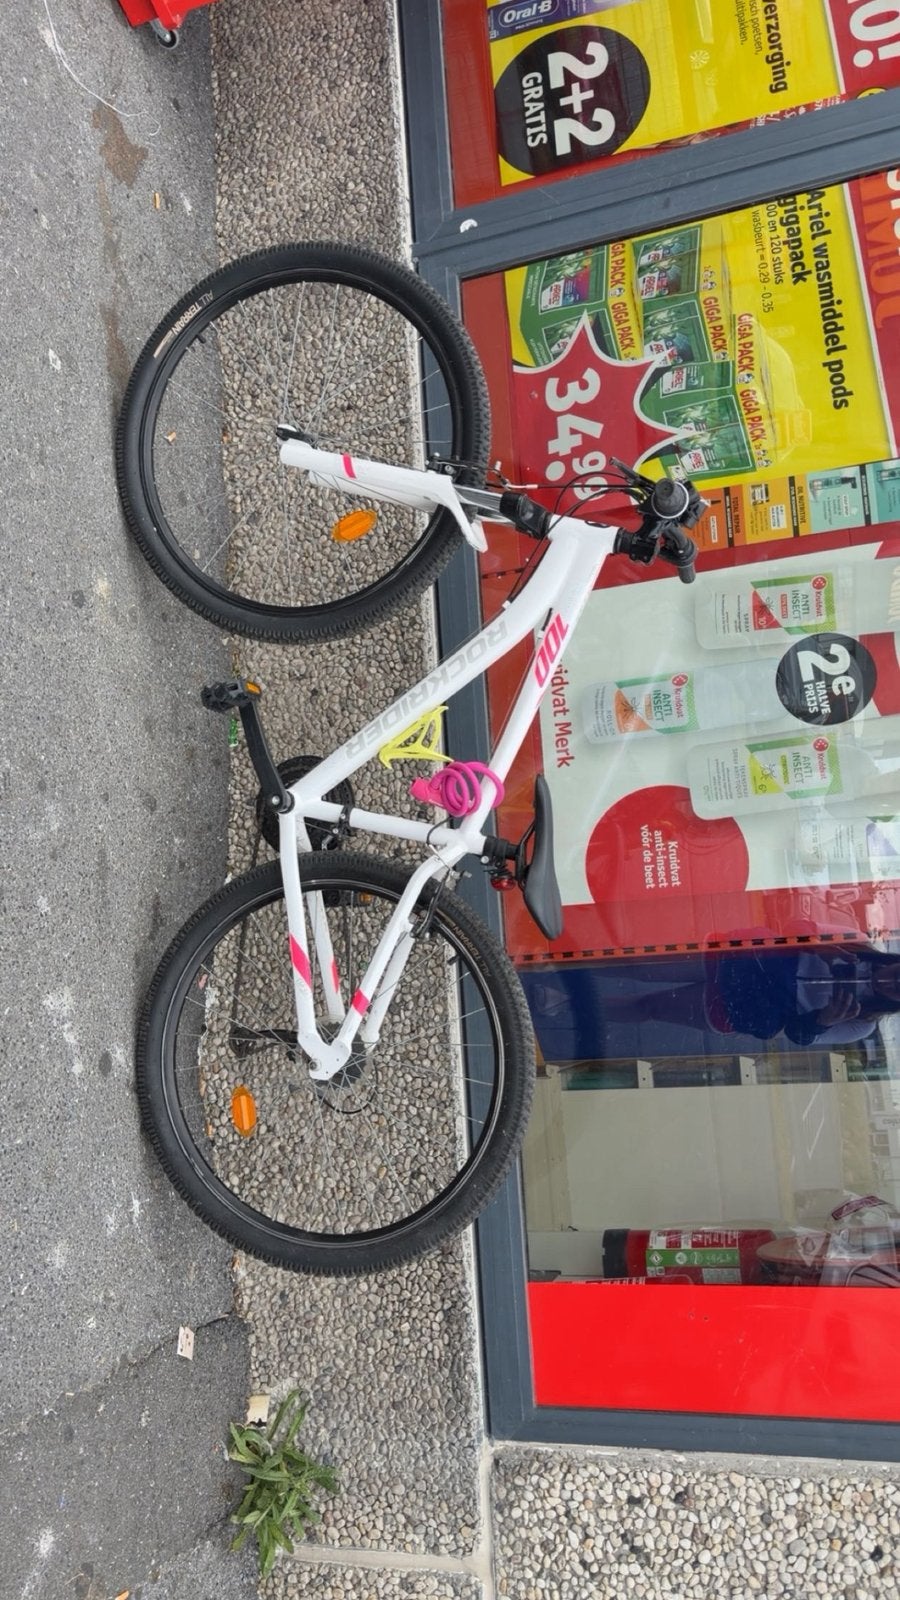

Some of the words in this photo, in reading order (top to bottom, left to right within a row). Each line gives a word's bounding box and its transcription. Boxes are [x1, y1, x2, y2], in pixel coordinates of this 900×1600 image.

[749, 18, 762, 55] poetsen,
[522, 72, 548, 147] GRATIS
[547, 42, 616, 156] 2+2
[766, 203, 778, 218] 00
[806, 190, 832, 240] Ariel
[751, 210, 766, 253] wasbeurt
[767, 221, 779, 232] en
[776, 194, 812, 286] gigapack
[611, 242, 626, 258] GA
[770, 235, 782, 254] 120
[610, 258, 626, 288] PACK
[758, 262, 770, 284] 0.29
[772, 255, 784, 285] stuks
[198, 290, 214, 304] ALL
[552, 284, 562, 304] ARIEL
[762, 292, 774, 313] 0.35
[812, 242, 847, 356] wasmiddel
[172, 302, 202, 335] TERRAIN
[612, 302, 630, 326] GIGA
[702, 296, 721, 324] GIGA
[616, 327, 636, 351] PACK
[708, 326, 728, 352] PACK
[738, 313, 752, 339] GIGA
[738, 342, 755, 374] PACK
[822, 359, 854, 410] pods
[739, 389, 760, 415] GIGA
[746, 416, 766, 442] PACK
[690, 452, 704, 470] ARIEL
[732, 496, 740, 514] TOTAL
[798, 496, 806, 524] NUTRITIVE
[792, 590, 801, 620] INSECT
[801, 594, 810, 615] ANTI
[815, 590, 823, 617] Kruidvat
[534, 614, 568, 688] 100
[796, 644, 856, 696] 2e
[345, 621, 507, 760] ROCKRIDER
[550, 664, 569, 718] idvat
[674, 688, 684, 718] Kruidvat
[804, 683, 818, 714] PRIJS
[816, 680, 831, 714] HALVE
[653, 690, 664, 722] INSECT
[662, 694, 672, 716] ANTI
[554, 722, 575, 768] Merk
[792, 752, 804, 784] INSECT
[802, 756, 812, 778] ANTI
[816, 754, 827, 780] Kruidvat
[640, 824, 651, 848] vóór
[643, 850, 652, 862] de
[654, 830, 668, 888] anti-insect
[668, 841, 682, 886] Kruidvat
[644, 865, 655, 889] beet
